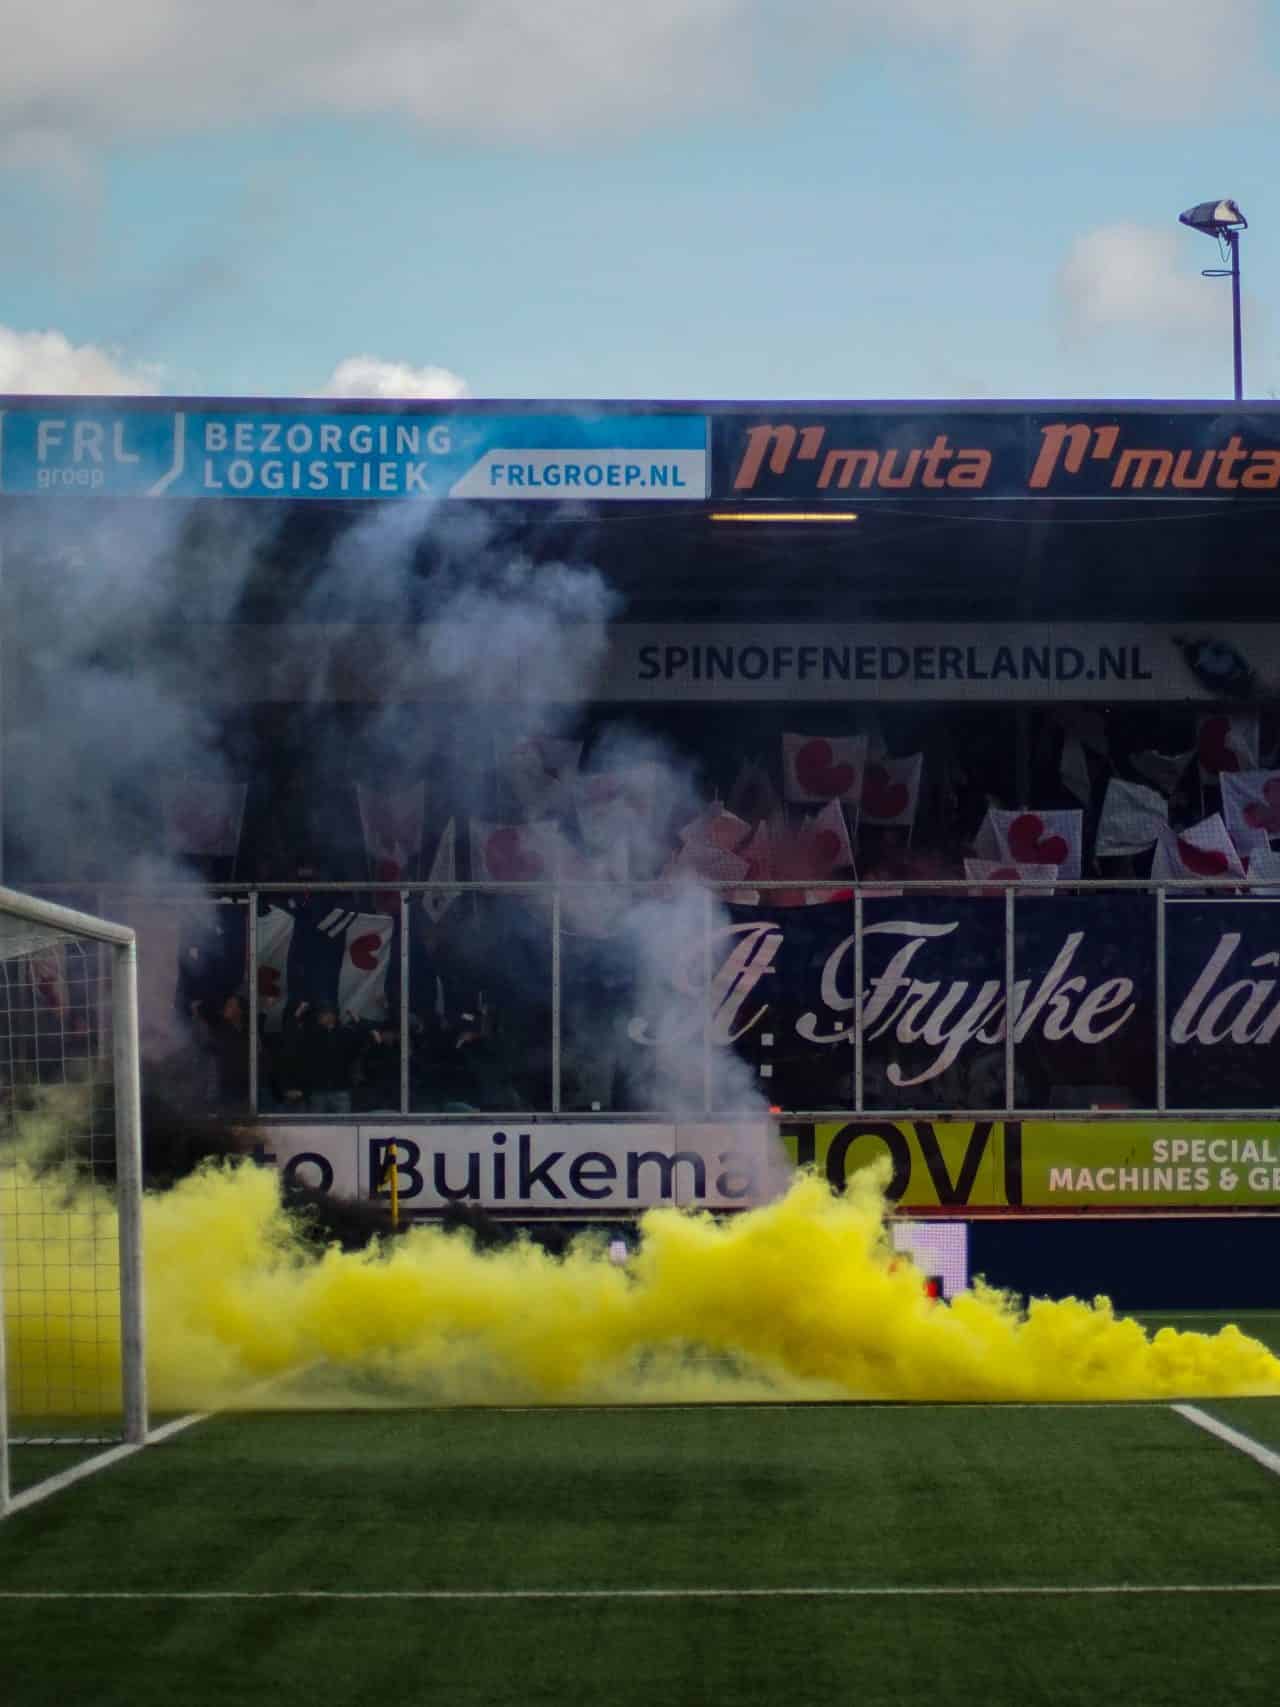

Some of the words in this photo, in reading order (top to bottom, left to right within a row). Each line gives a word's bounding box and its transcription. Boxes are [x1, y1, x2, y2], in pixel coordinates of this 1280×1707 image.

[37, 420, 140, 463] FRL
[204, 423, 450, 454] BEZORGING
[37, 466, 104, 488] groep
[203, 459, 431, 491] LOGISTIEK
[489, 464, 687, 487] FRLGROEP.NL
[816, 435, 991, 488] muta
[638, 645, 1153, 680] SPINOFFNEDERLAND.NL
[795, 920, 1136, 1087] Fryske
[369, 1132, 757, 1201] Buikema
[1048, 1168, 1209, 1192] MACHINES
[1218, 1168, 1239, 1192] &
